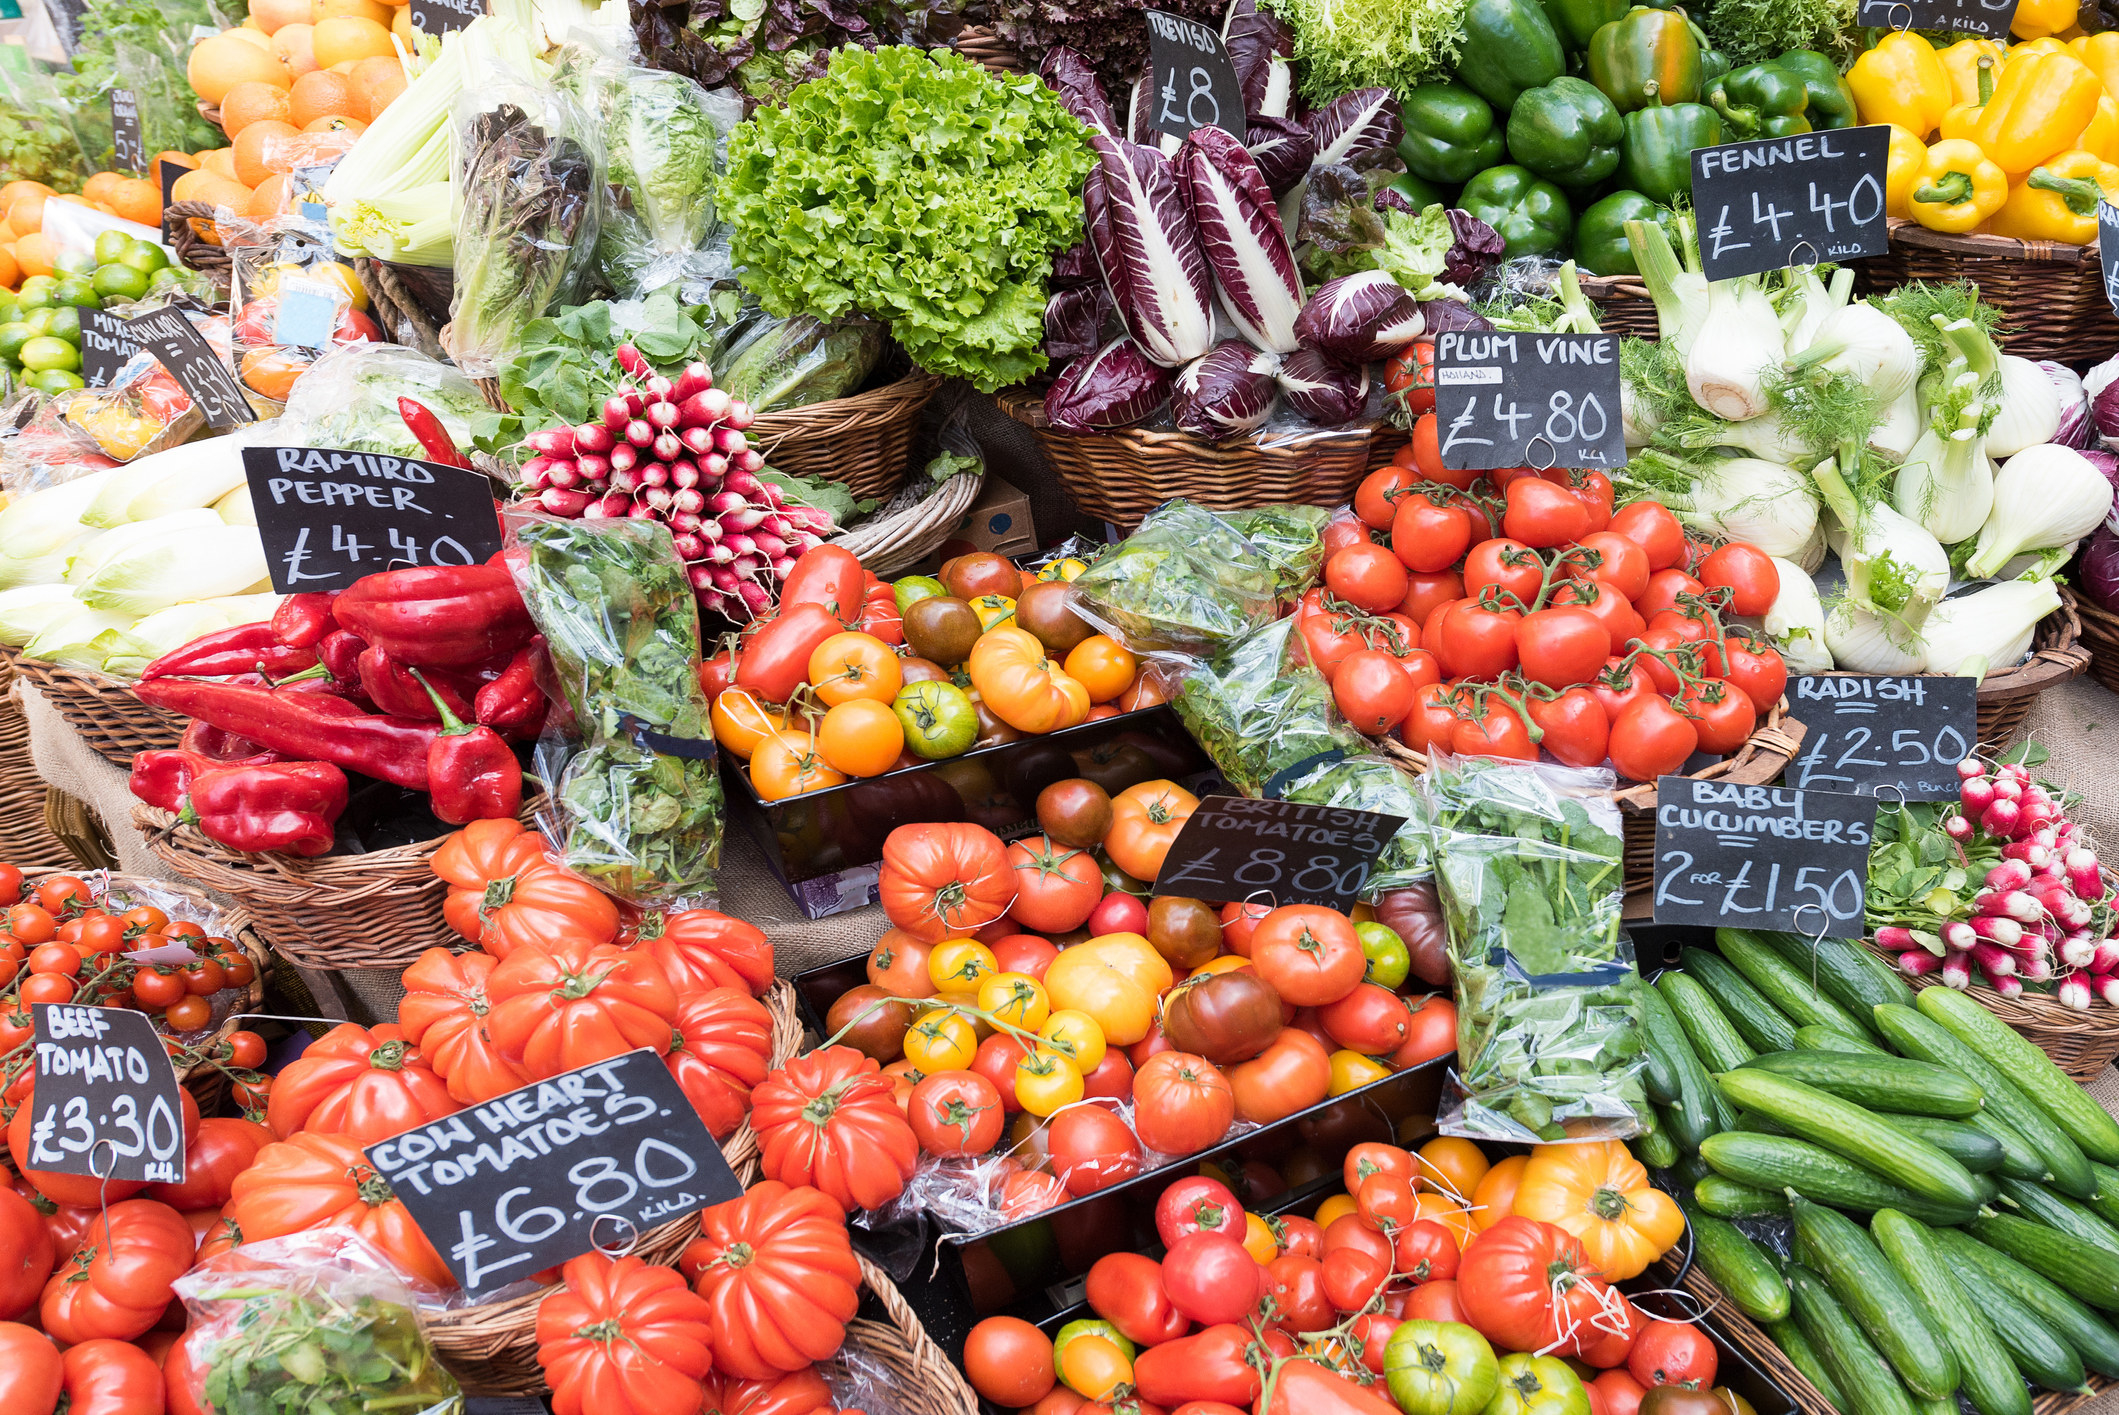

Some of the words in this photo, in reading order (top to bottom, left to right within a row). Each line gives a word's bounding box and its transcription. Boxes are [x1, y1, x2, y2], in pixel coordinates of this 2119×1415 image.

[1160, 66, 1219, 128] £8
[1708, 172, 1883, 260] £4.40
[1440, 332, 1518, 363] PLUM
[1536, 337, 1613, 365] VINE
[1442, 390, 1608, 457] £4.80
[276, 447, 435, 484] RAMIRO
[282, 524, 475, 586] £4.40
[1797, 724, 1967, 789] £2.50
[1692, 781, 1805, 823] BABY
[1897, 780, 1912, 791] A
[1222, 799, 1381, 831] BRITISH
[1658, 803, 1871, 846] CUCUMBERS
[1163, 847, 1370, 896] £8.80
[1656, 850, 1704, 906] 2
[1690, 871, 1723, 885] FOR
[1719, 860, 1864, 921] £1.50
[1282, 895, 1296, 904] A
[47, 1004, 111, 1041] BEEF
[36, 1042, 150, 1086] TOMATO
[32, 1094, 180, 1165] £3.30
[372, 1116, 476, 1172] COW
[474, 1057, 631, 1134] HEART
[450, 1137, 698, 1289] £6.80
